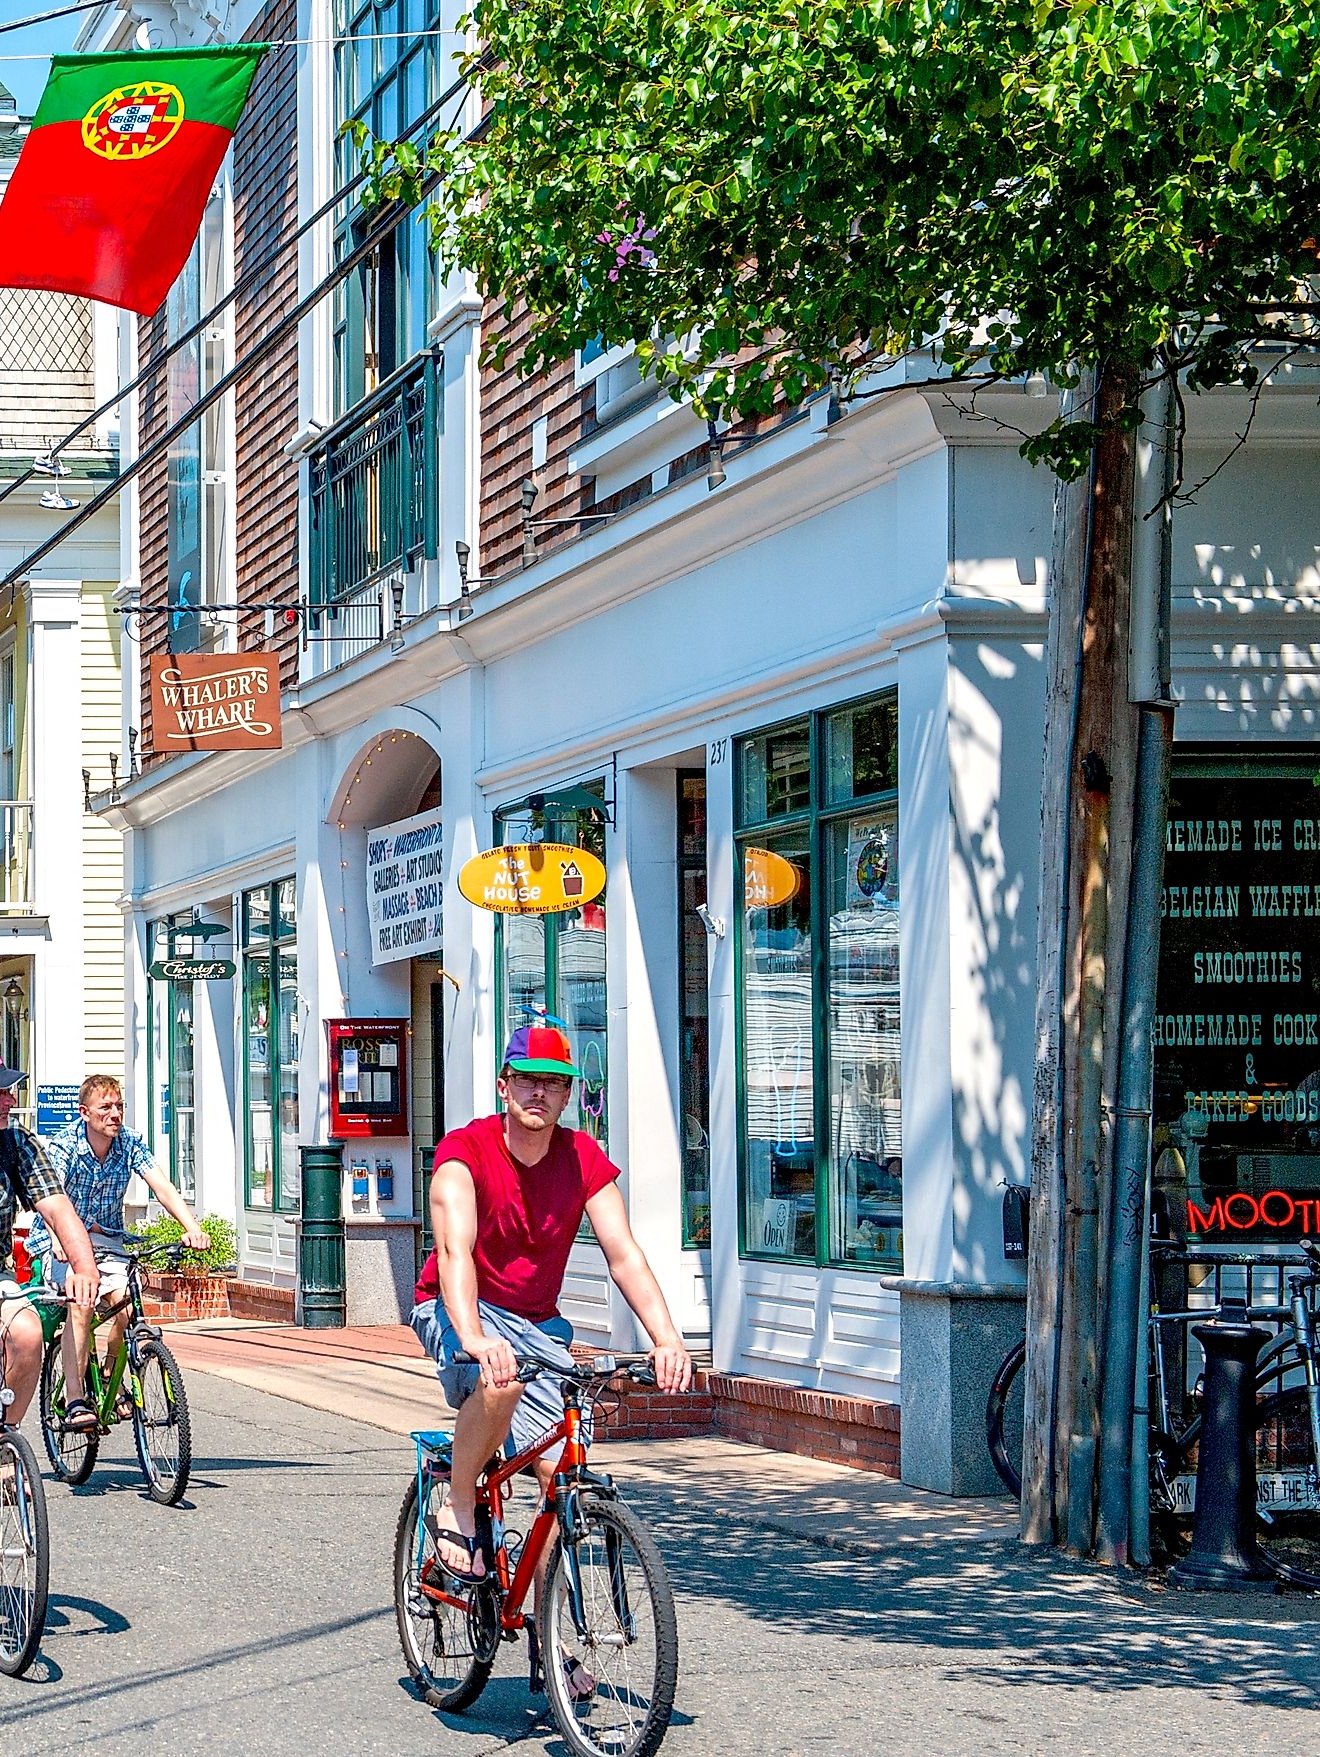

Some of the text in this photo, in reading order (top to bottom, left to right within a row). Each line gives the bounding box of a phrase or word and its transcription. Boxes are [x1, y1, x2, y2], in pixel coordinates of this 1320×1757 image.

[161, 671, 268, 707] WHALER'S
[175, 699, 256, 731] WHARF
[710, 738, 727, 766] 237
[1254, 819, 1282, 851] ICE
[481, 848, 501, 859] GELATO
[542, 845, 574, 854] SMOOTHIES
[498, 856, 525, 870] The
[373, 863, 400, 894] GALLERIES
[406, 857, 417, 883] ART
[493, 871, 530, 886] NUT
[382, 891, 409, 921] MASSAGE
[415, 883, 438, 911] BEACH
[563, 900, 580, 908] CREAM
[379, 926, 391, 952] FREE
[392, 923, 403, 948] ART
[403, 917, 427, 946] EXHIBIT
[159, 961, 226, 977] Christof's
[1194, 951, 1302, 983] SMOOTHIES
[1154, 1014, 1262, 1046] HOMEMADE
[1245, 1053, 1258, 1085] &
[1185, 1090, 1320, 1122] BAKED GOODS
[764, 1220, 785, 1247] OPEN
[1282, 1480, 1302, 1503] THE
